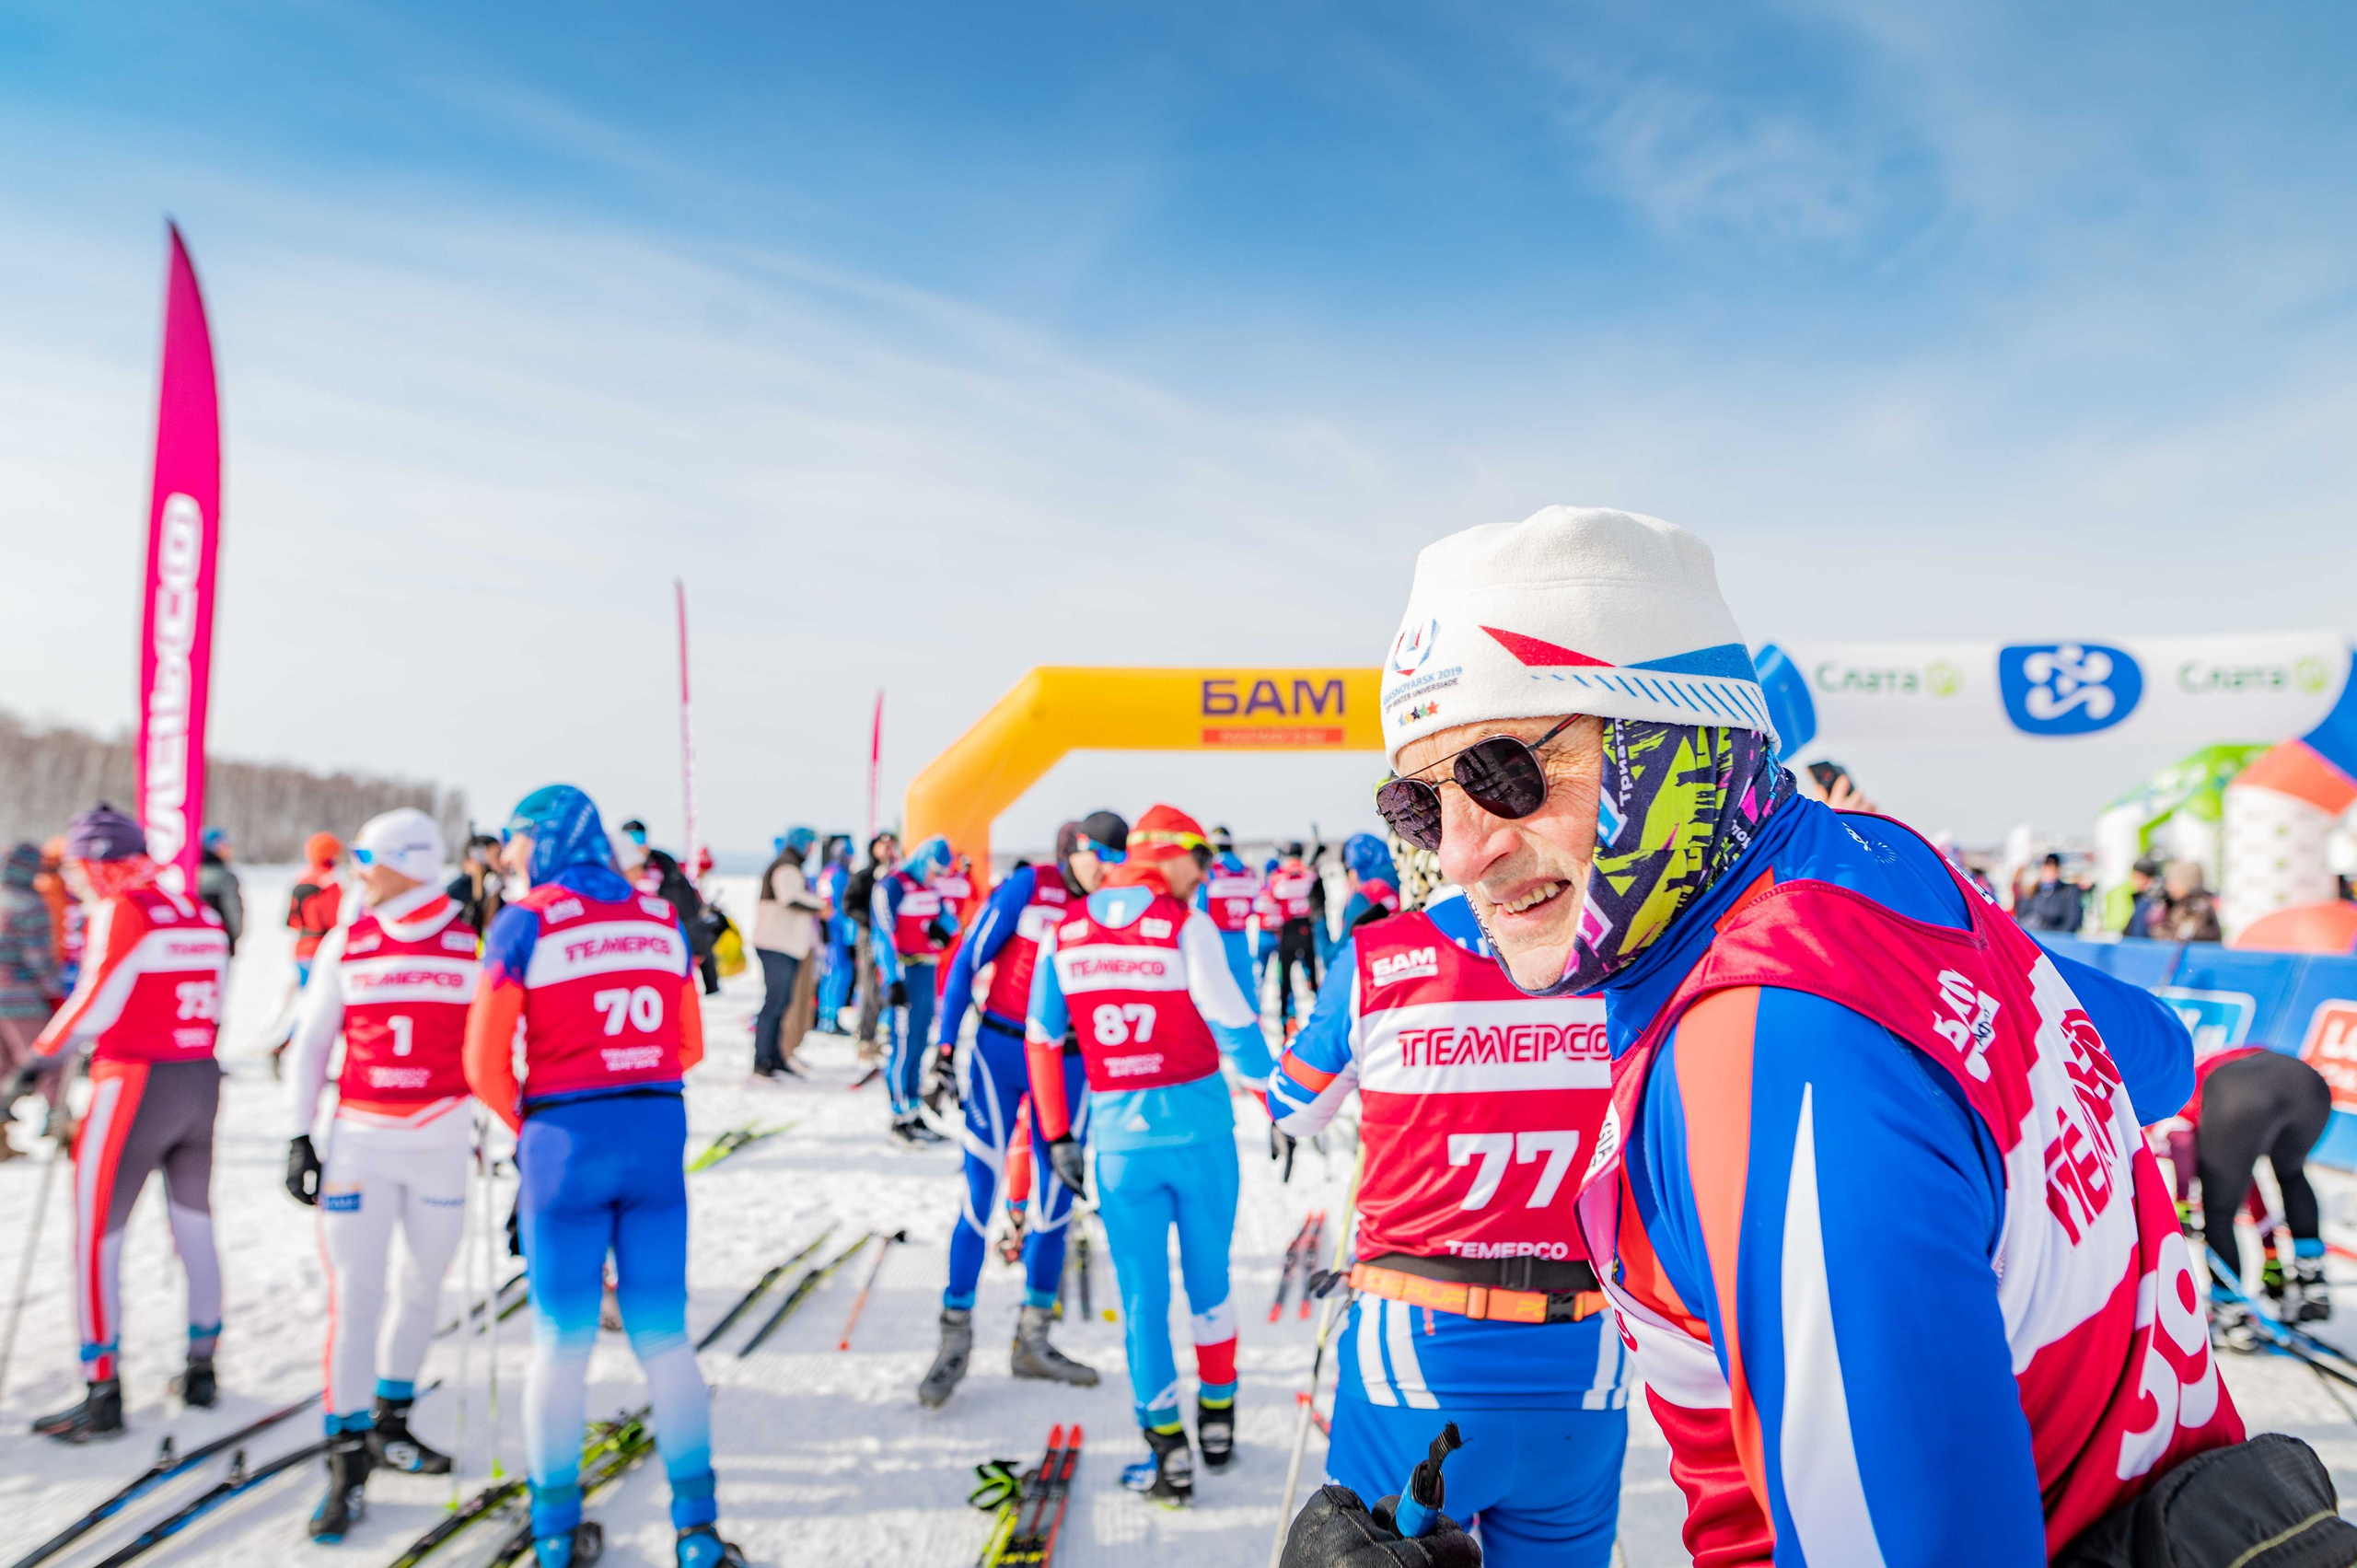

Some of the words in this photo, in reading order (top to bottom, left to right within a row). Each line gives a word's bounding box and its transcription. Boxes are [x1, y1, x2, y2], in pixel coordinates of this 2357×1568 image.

[1437, 666, 1462, 679] 2019
[1202, 679, 1344, 716] БАМ
[1372, 947, 1436, 977] БАМ
[594, 985, 664, 1037] 70
[1092, 1003, 1156, 1046] 87
[388, 1016, 413, 1057] 1
[1447, 1130, 1580, 1211] 77
